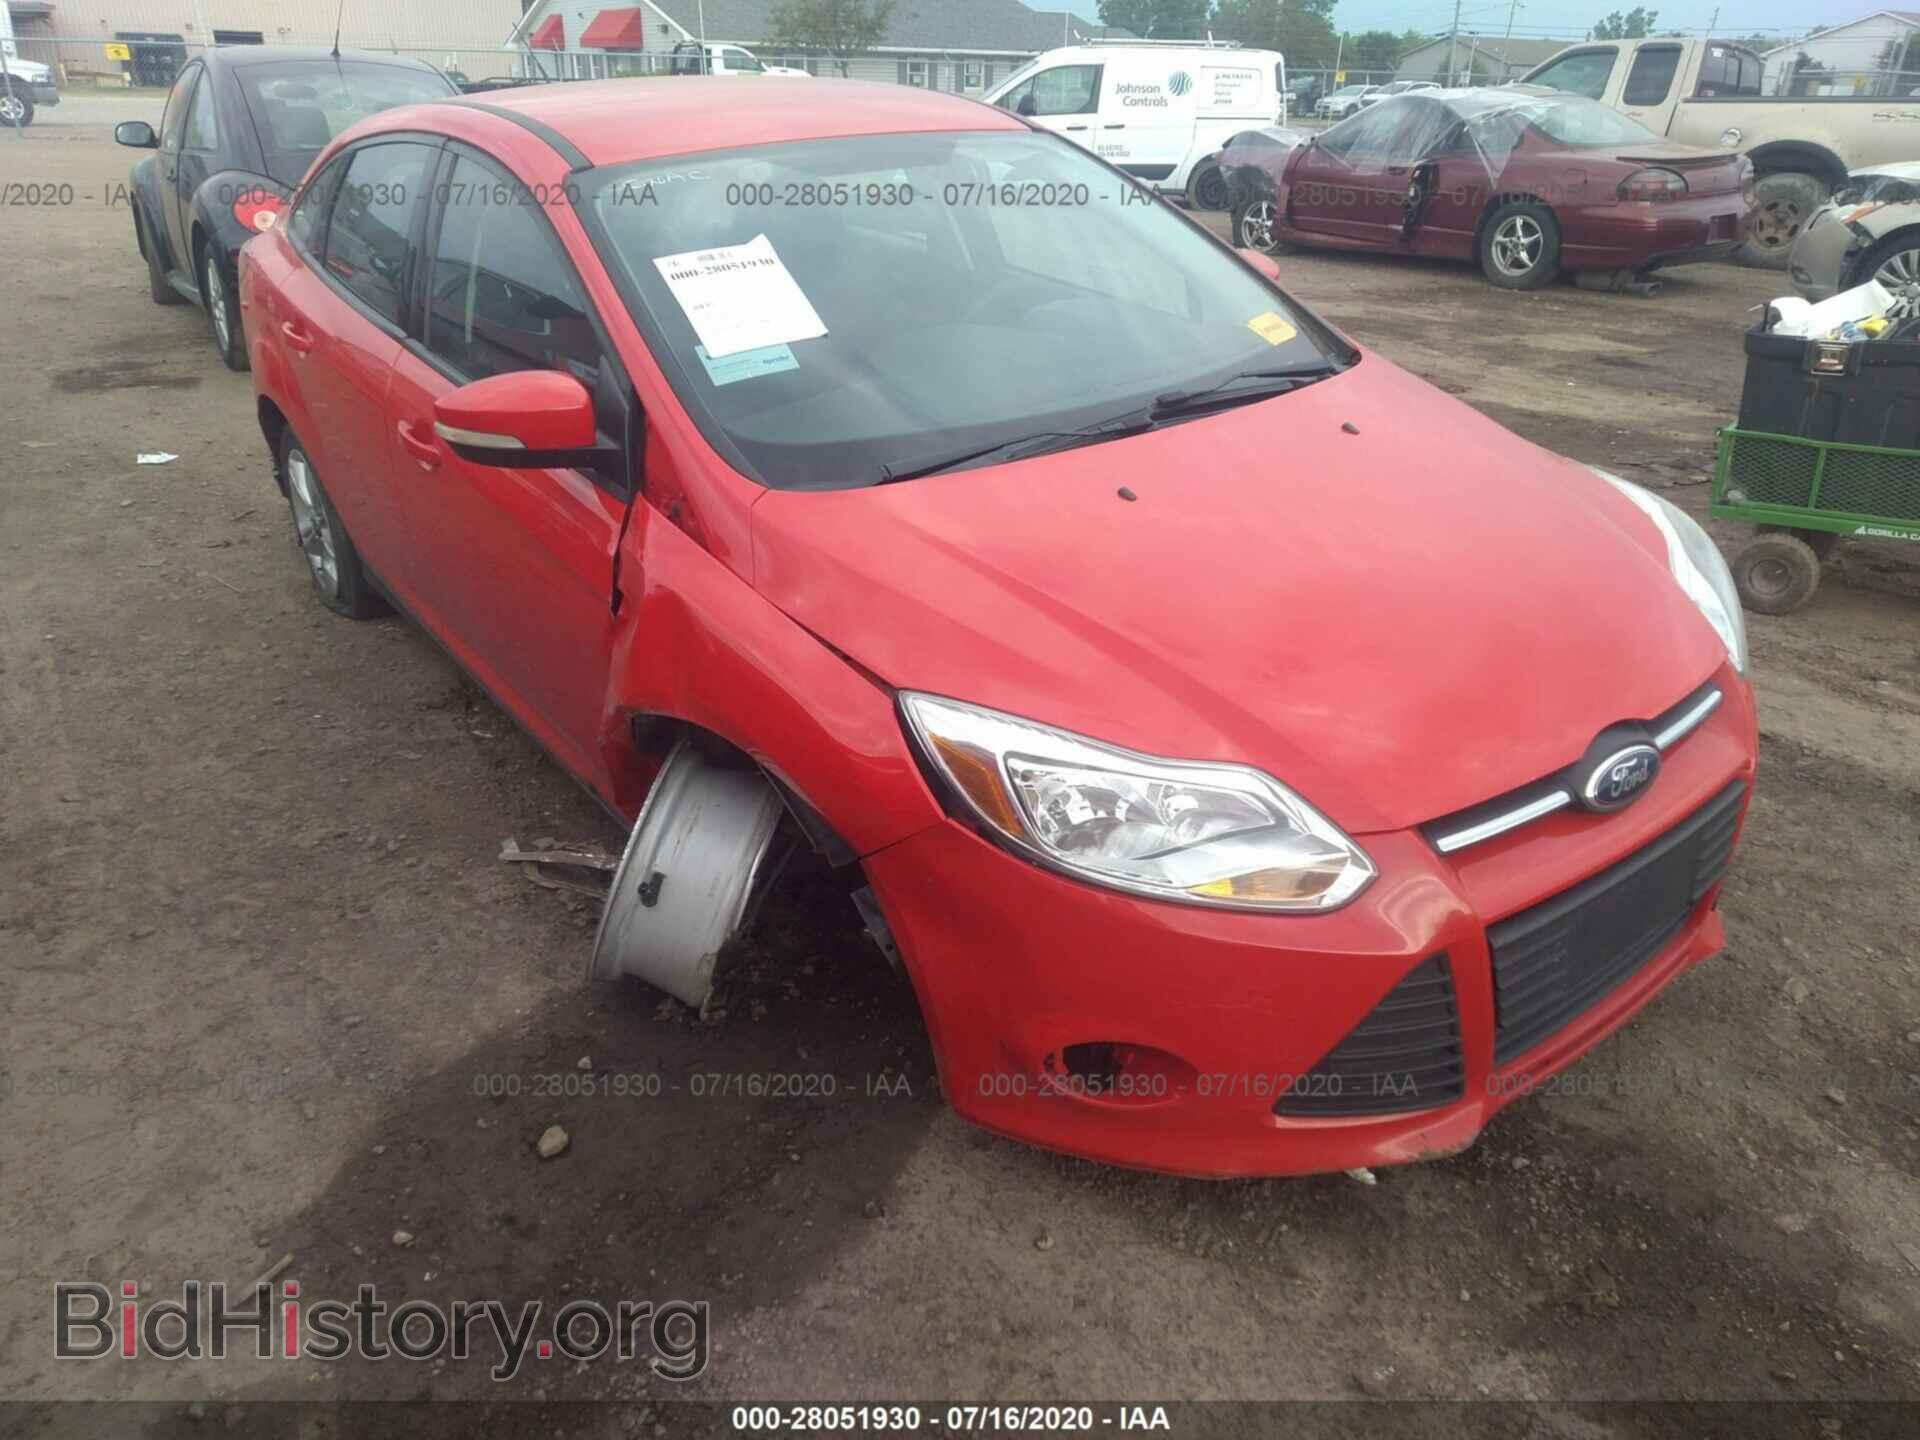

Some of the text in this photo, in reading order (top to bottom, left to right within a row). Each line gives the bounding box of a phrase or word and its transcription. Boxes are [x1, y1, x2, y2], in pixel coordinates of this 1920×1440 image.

[1115, 83, 1161, 95] Johnson
[1122, 96, 1168, 107] Controls
[1867, 528, 1908, 538] GORILLA
[1611, 758, 1648, 797] Ford
